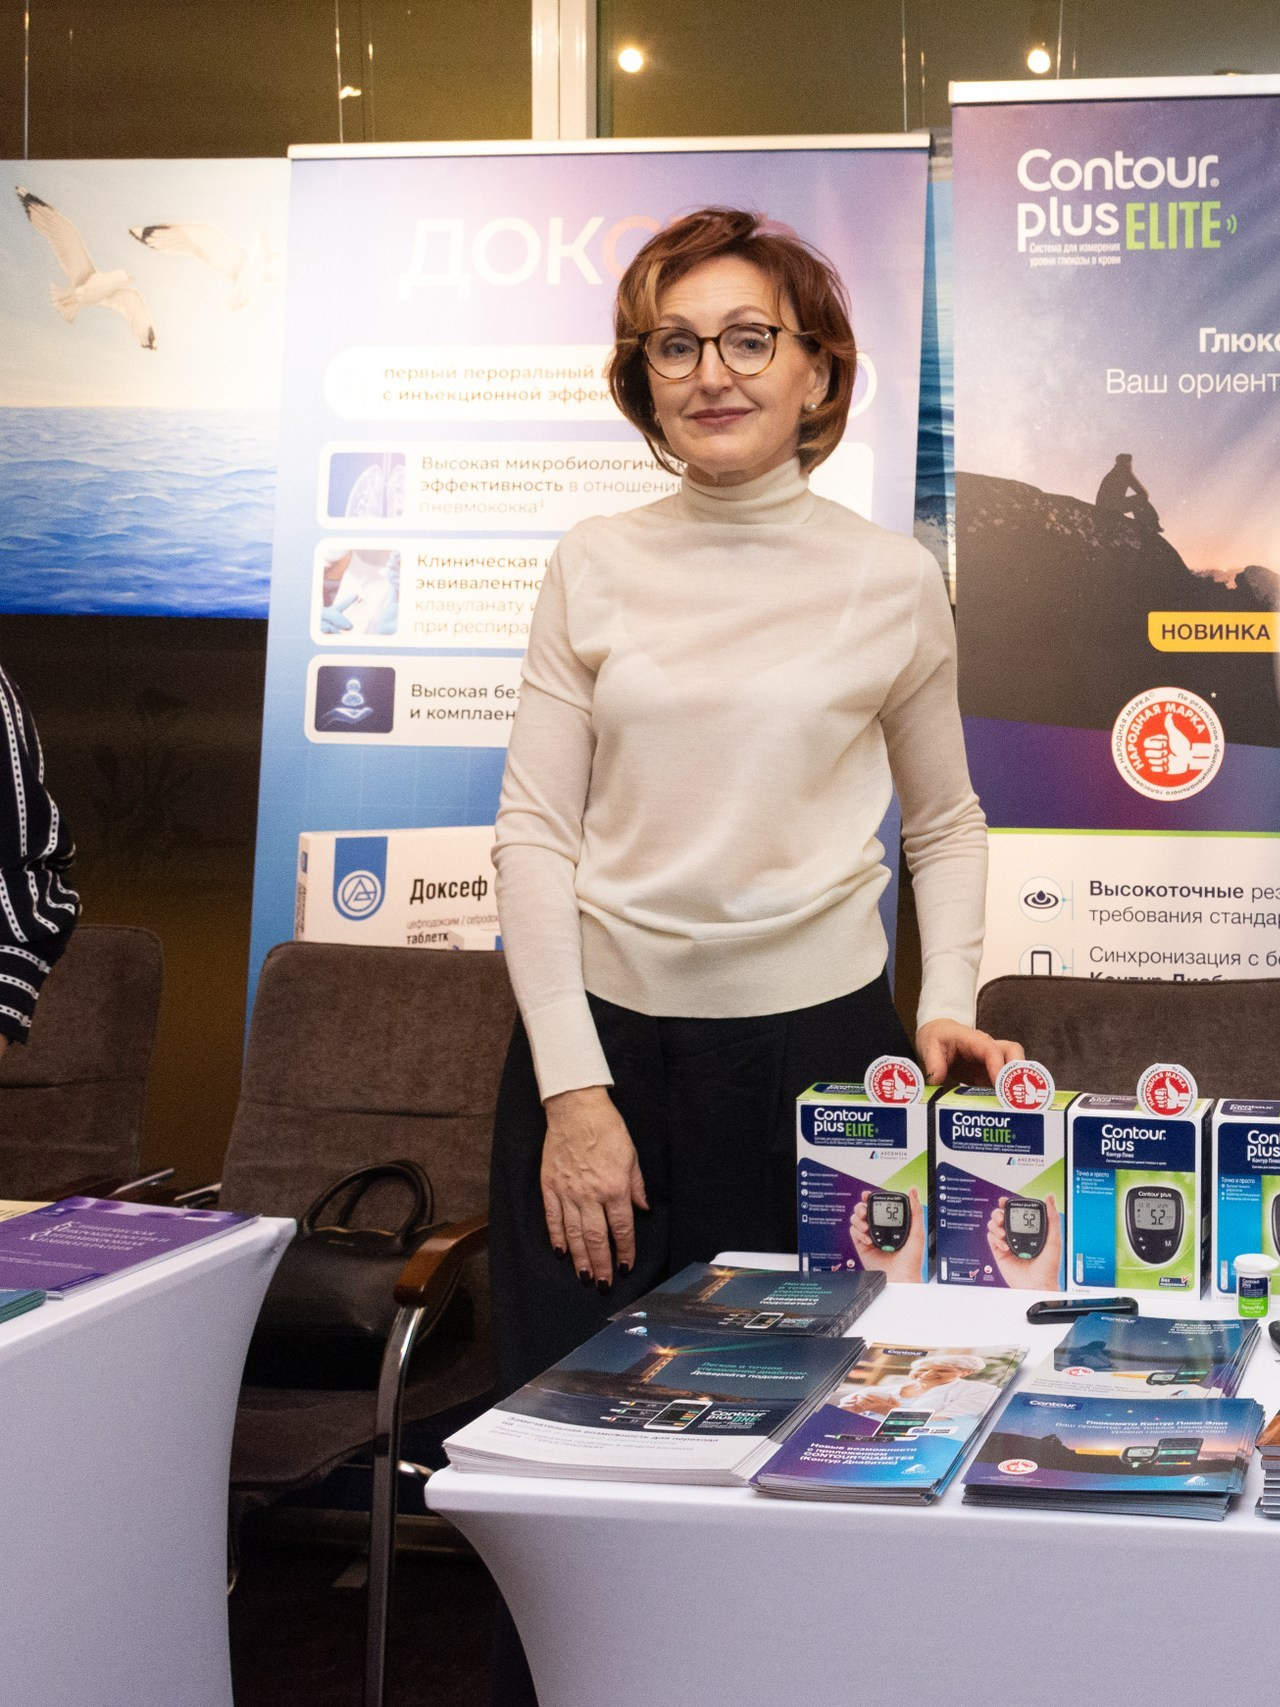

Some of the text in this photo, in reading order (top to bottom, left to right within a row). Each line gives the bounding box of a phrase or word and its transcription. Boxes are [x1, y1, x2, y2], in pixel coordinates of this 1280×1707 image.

[1016, 196, 1221, 252] plus ELITE
[1029, 242, 1121, 255] Система для измерения
[1029, 256, 1056, 268] уровня
[1057, 256, 1090, 266] глюкозы
[1098, 255, 1121, 267] крови
[384, 365, 457, 382] первый
[464, 365, 594, 381] пероральный
[1105, 368, 1168, 394] Ваш
[399, 388, 542, 403] инъекционной
[421, 456, 499, 471] Высокая
[420, 477, 563, 495] эффективность
[583, 480, 682, 494] отношени
[417, 554, 537, 569] Клиническая
[415, 600, 525, 616] клавуланату
[414, 621, 447, 637] при
[1161, 622, 1271, 642] НОВИНКА
[411, 683, 488, 699] Высокая
[410, 708, 420, 719] и
[1116, 718, 1127, 764] НАРОДНАЯ
[1127, 702, 1207, 771] НАРОДНАЯ МАРКА
[410, 875, 488, 906] Доксеф
[1089, 880, 1244, 899] Высокоточные
[1089, 907, 1202, 926] требования
[1089, 946, 1241, 968] Синхронизация
[1248, 953, 1259, 966] с
[874, 1064, 893, 1097] НАРОДНАЯ
[894, 1063, 915, 1082] МАРКА
[1004, 1068, 1022, 1102] НАРОДНАЯ
[1023, 1068, 1044, 1085] МАРКА
[1145, 1071, 1186, 1107] НАРОДНАЯ МАРКА
[814, 1107, 874, 1122] Contour
[952, 1112, 1011, 1128] Contour
[814, 1121, 874, 1138] plus ELITE
[952, 1125, 1012, 1144] plus ELITE
[1101, 1138, 1135, 1155] plus
[1247, 1144, 1280, 1161] plus
[1100, 1315, 1137, 1324] Contour
[1029, 1400, 1077, 1410] Contour
[711, 1410, 767, 1418] Contour
[810, 1442, 845, 1451] Новые
[815, 1448, 888, 1457] приложением
[799, 1456, 841, 1465] (Контур
